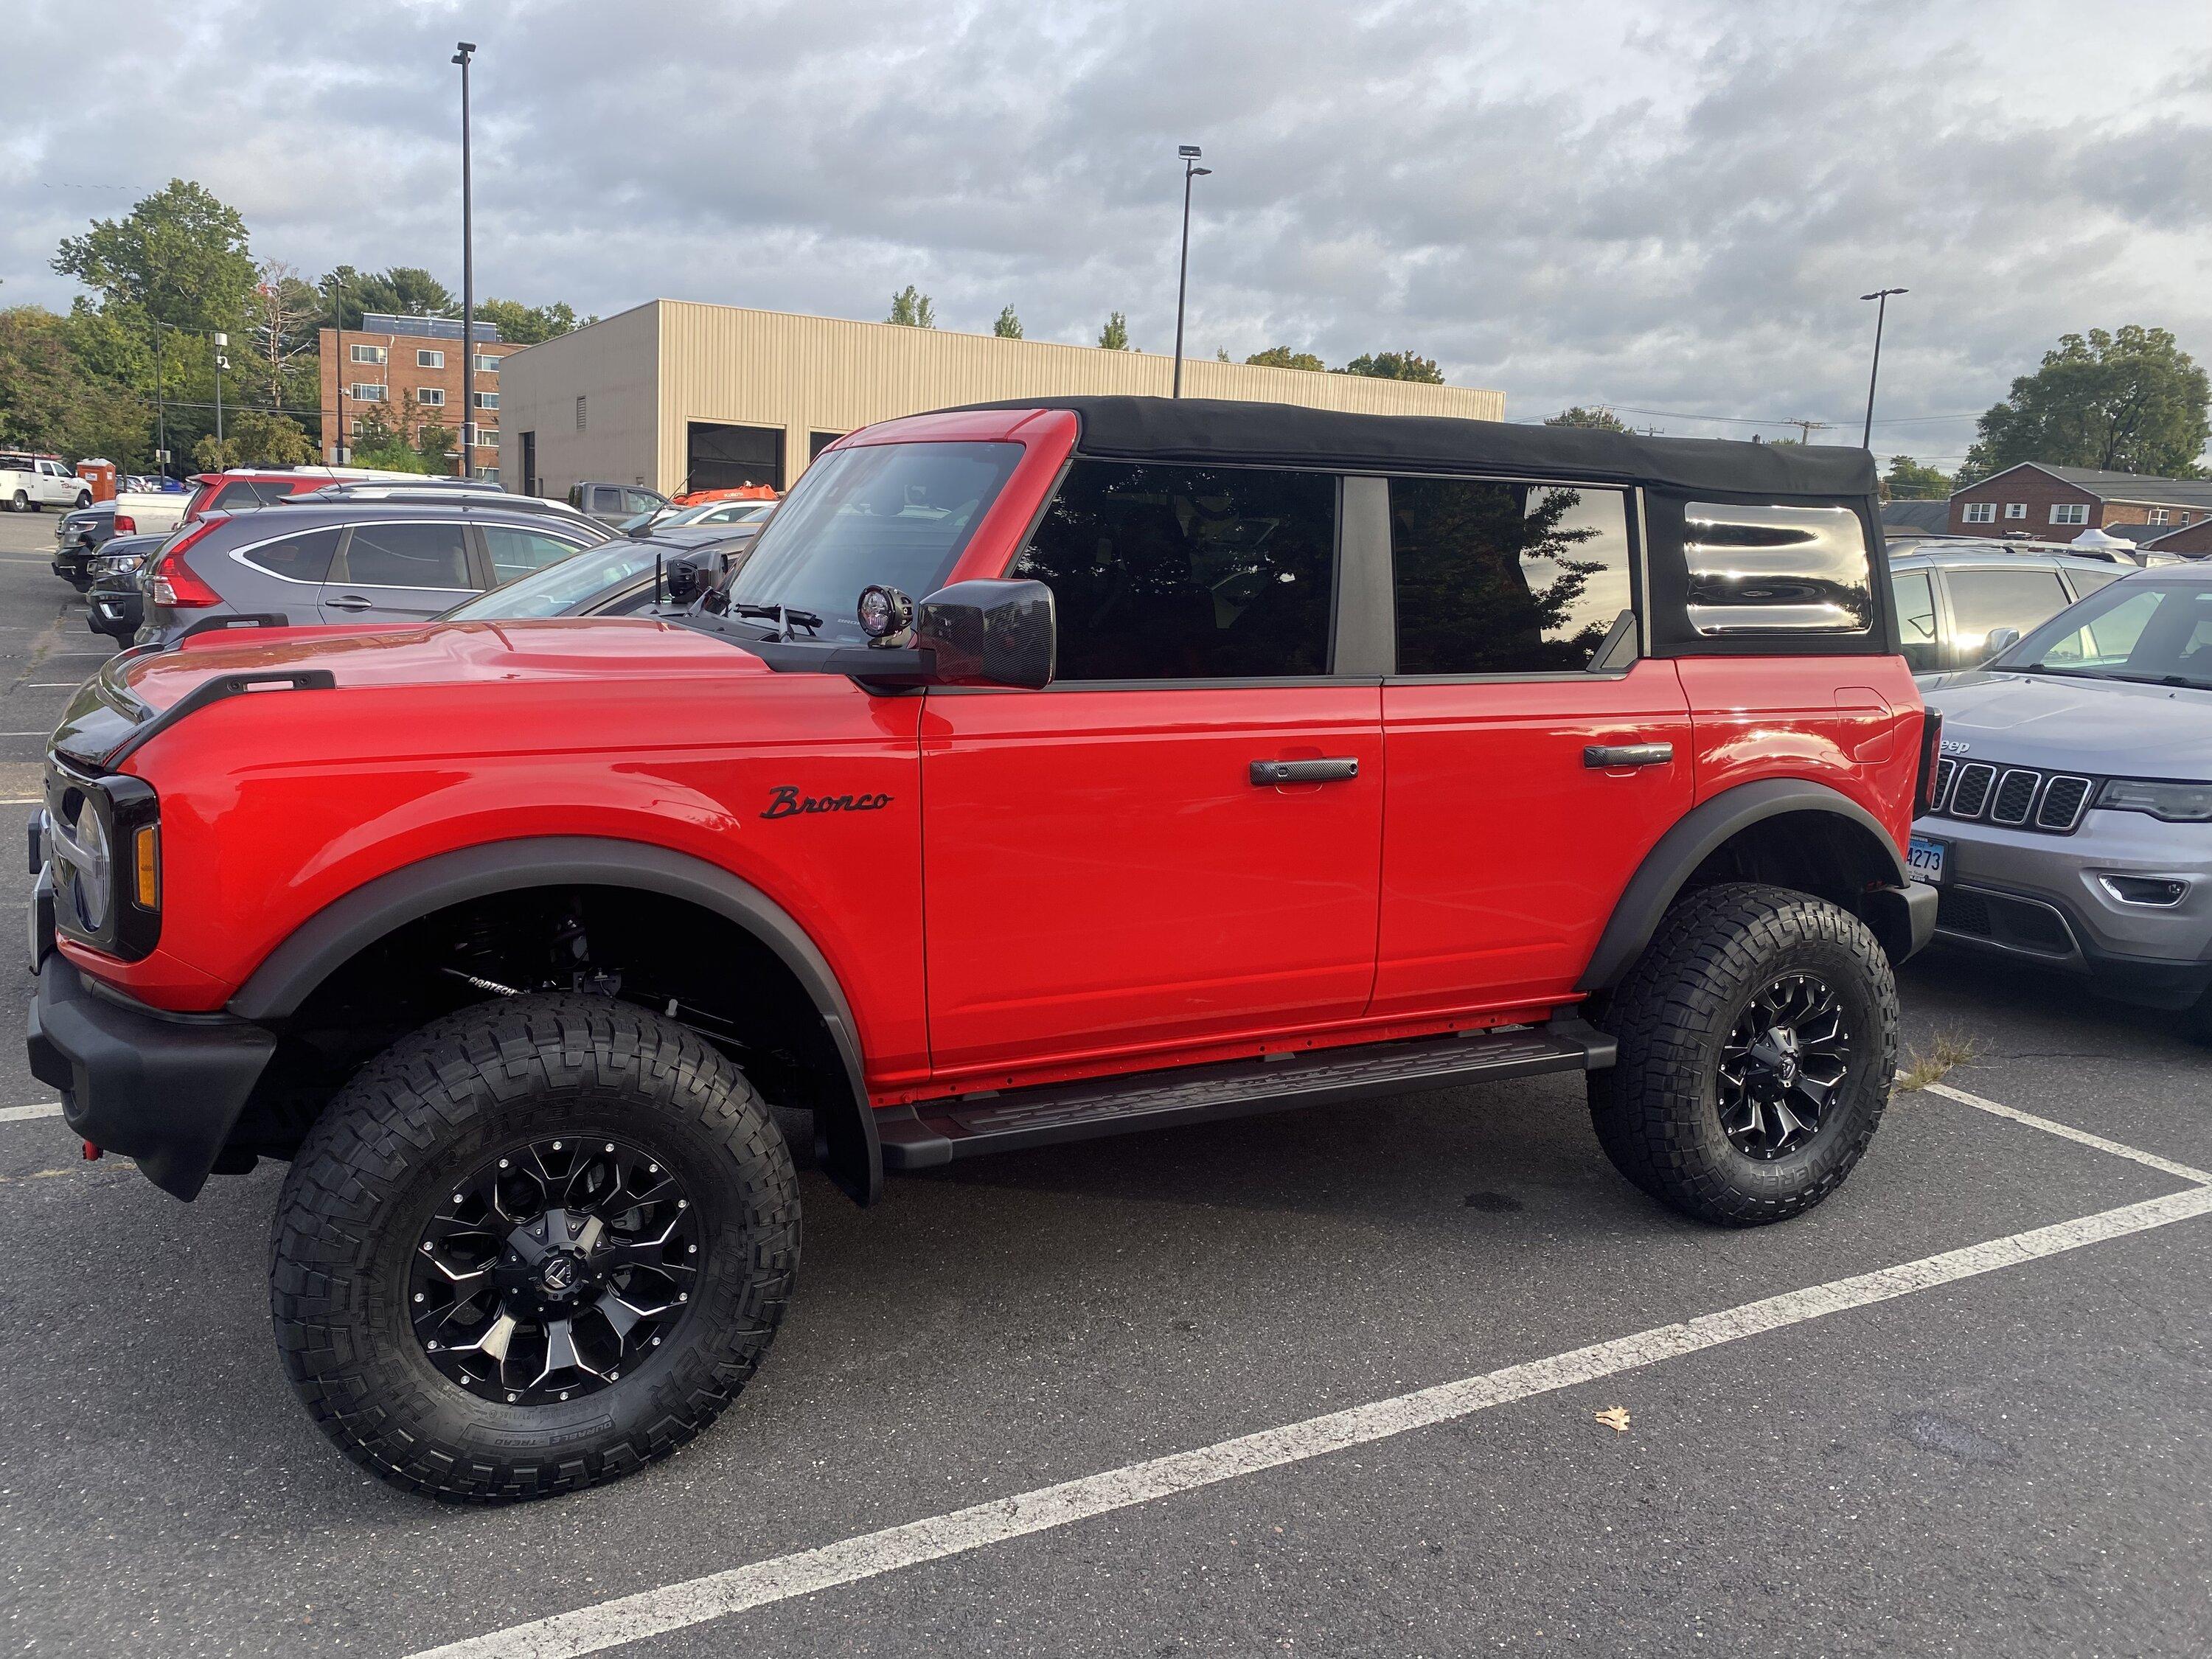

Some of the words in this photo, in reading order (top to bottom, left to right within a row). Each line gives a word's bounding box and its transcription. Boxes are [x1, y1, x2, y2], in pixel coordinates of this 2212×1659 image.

[1941, 740, 1970, 754] eep
[759, 785, 894, 818] Bronco
[1906, 847, 1941, 871] 4273
